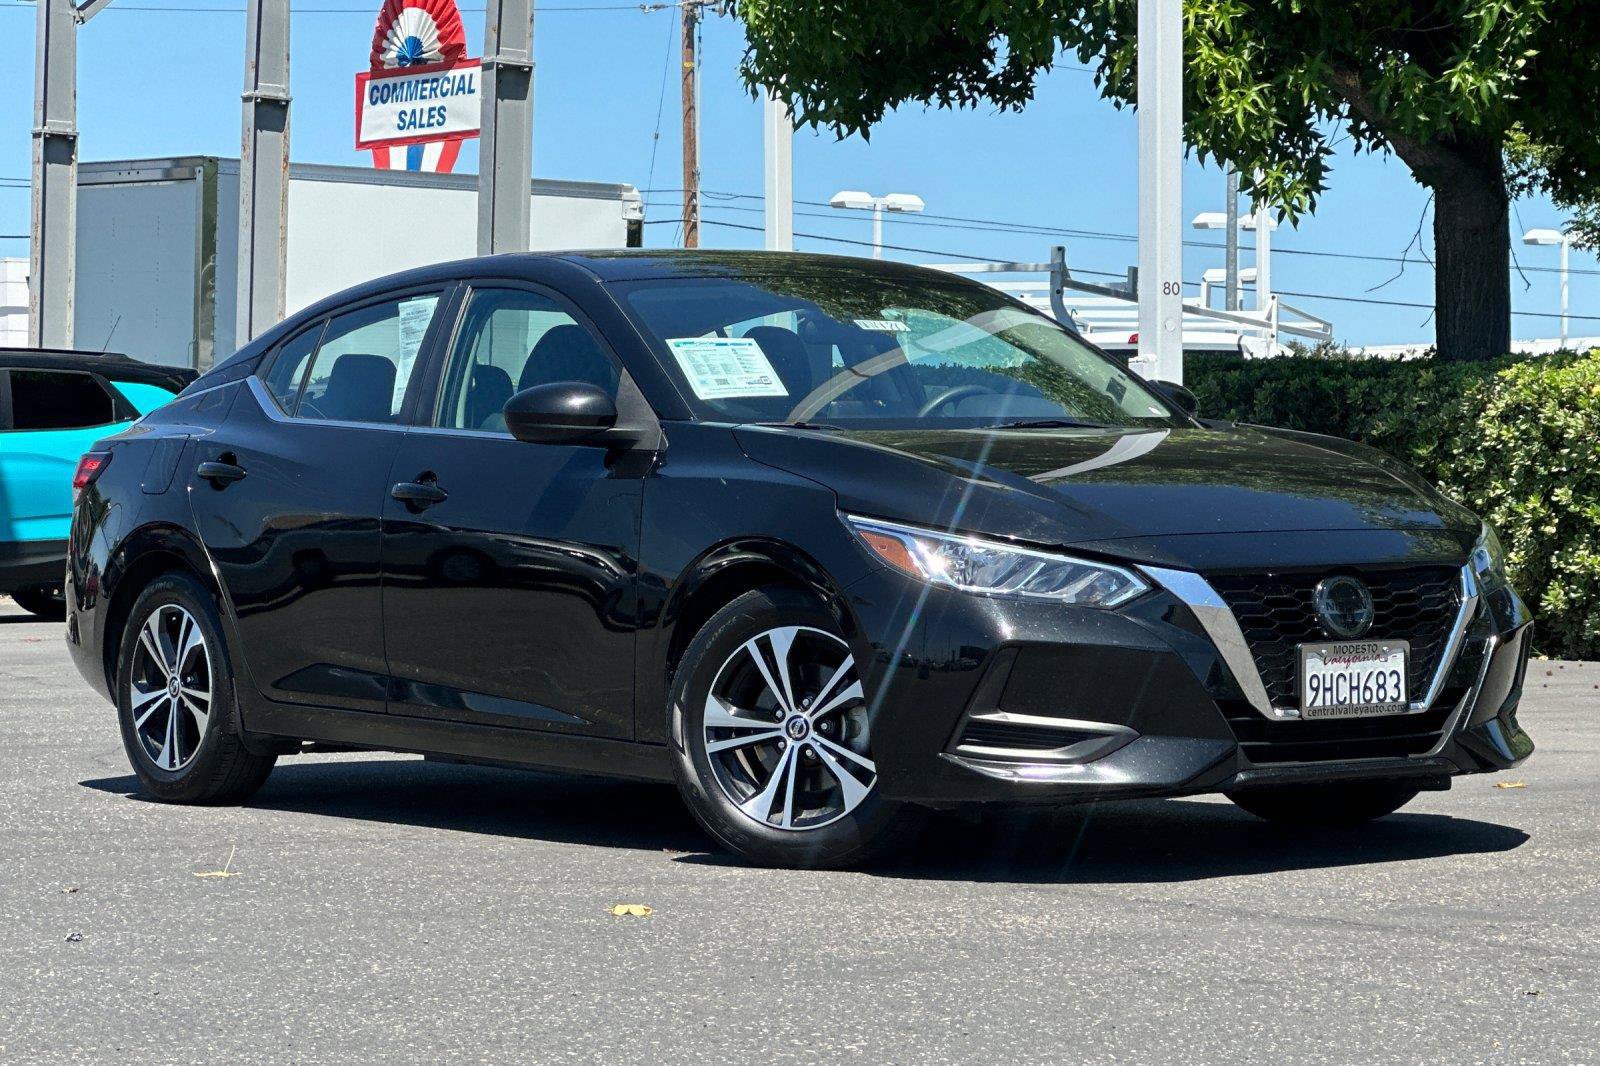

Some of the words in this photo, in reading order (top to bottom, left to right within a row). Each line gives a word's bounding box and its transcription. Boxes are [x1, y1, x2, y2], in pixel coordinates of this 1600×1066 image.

[370, 73, 476, 106] COMMERCIAL
[397, 105, 447, 131] SALES
[1163, 281, 1180, 296] 80
[1333, 643, 1378, 655] MODESTO
[1323, 653, 1382, 669] California
[1309, 669, 1401, 708] 9HCH683
[1307, 703, 1407, 717] centralvalleyauto.com
